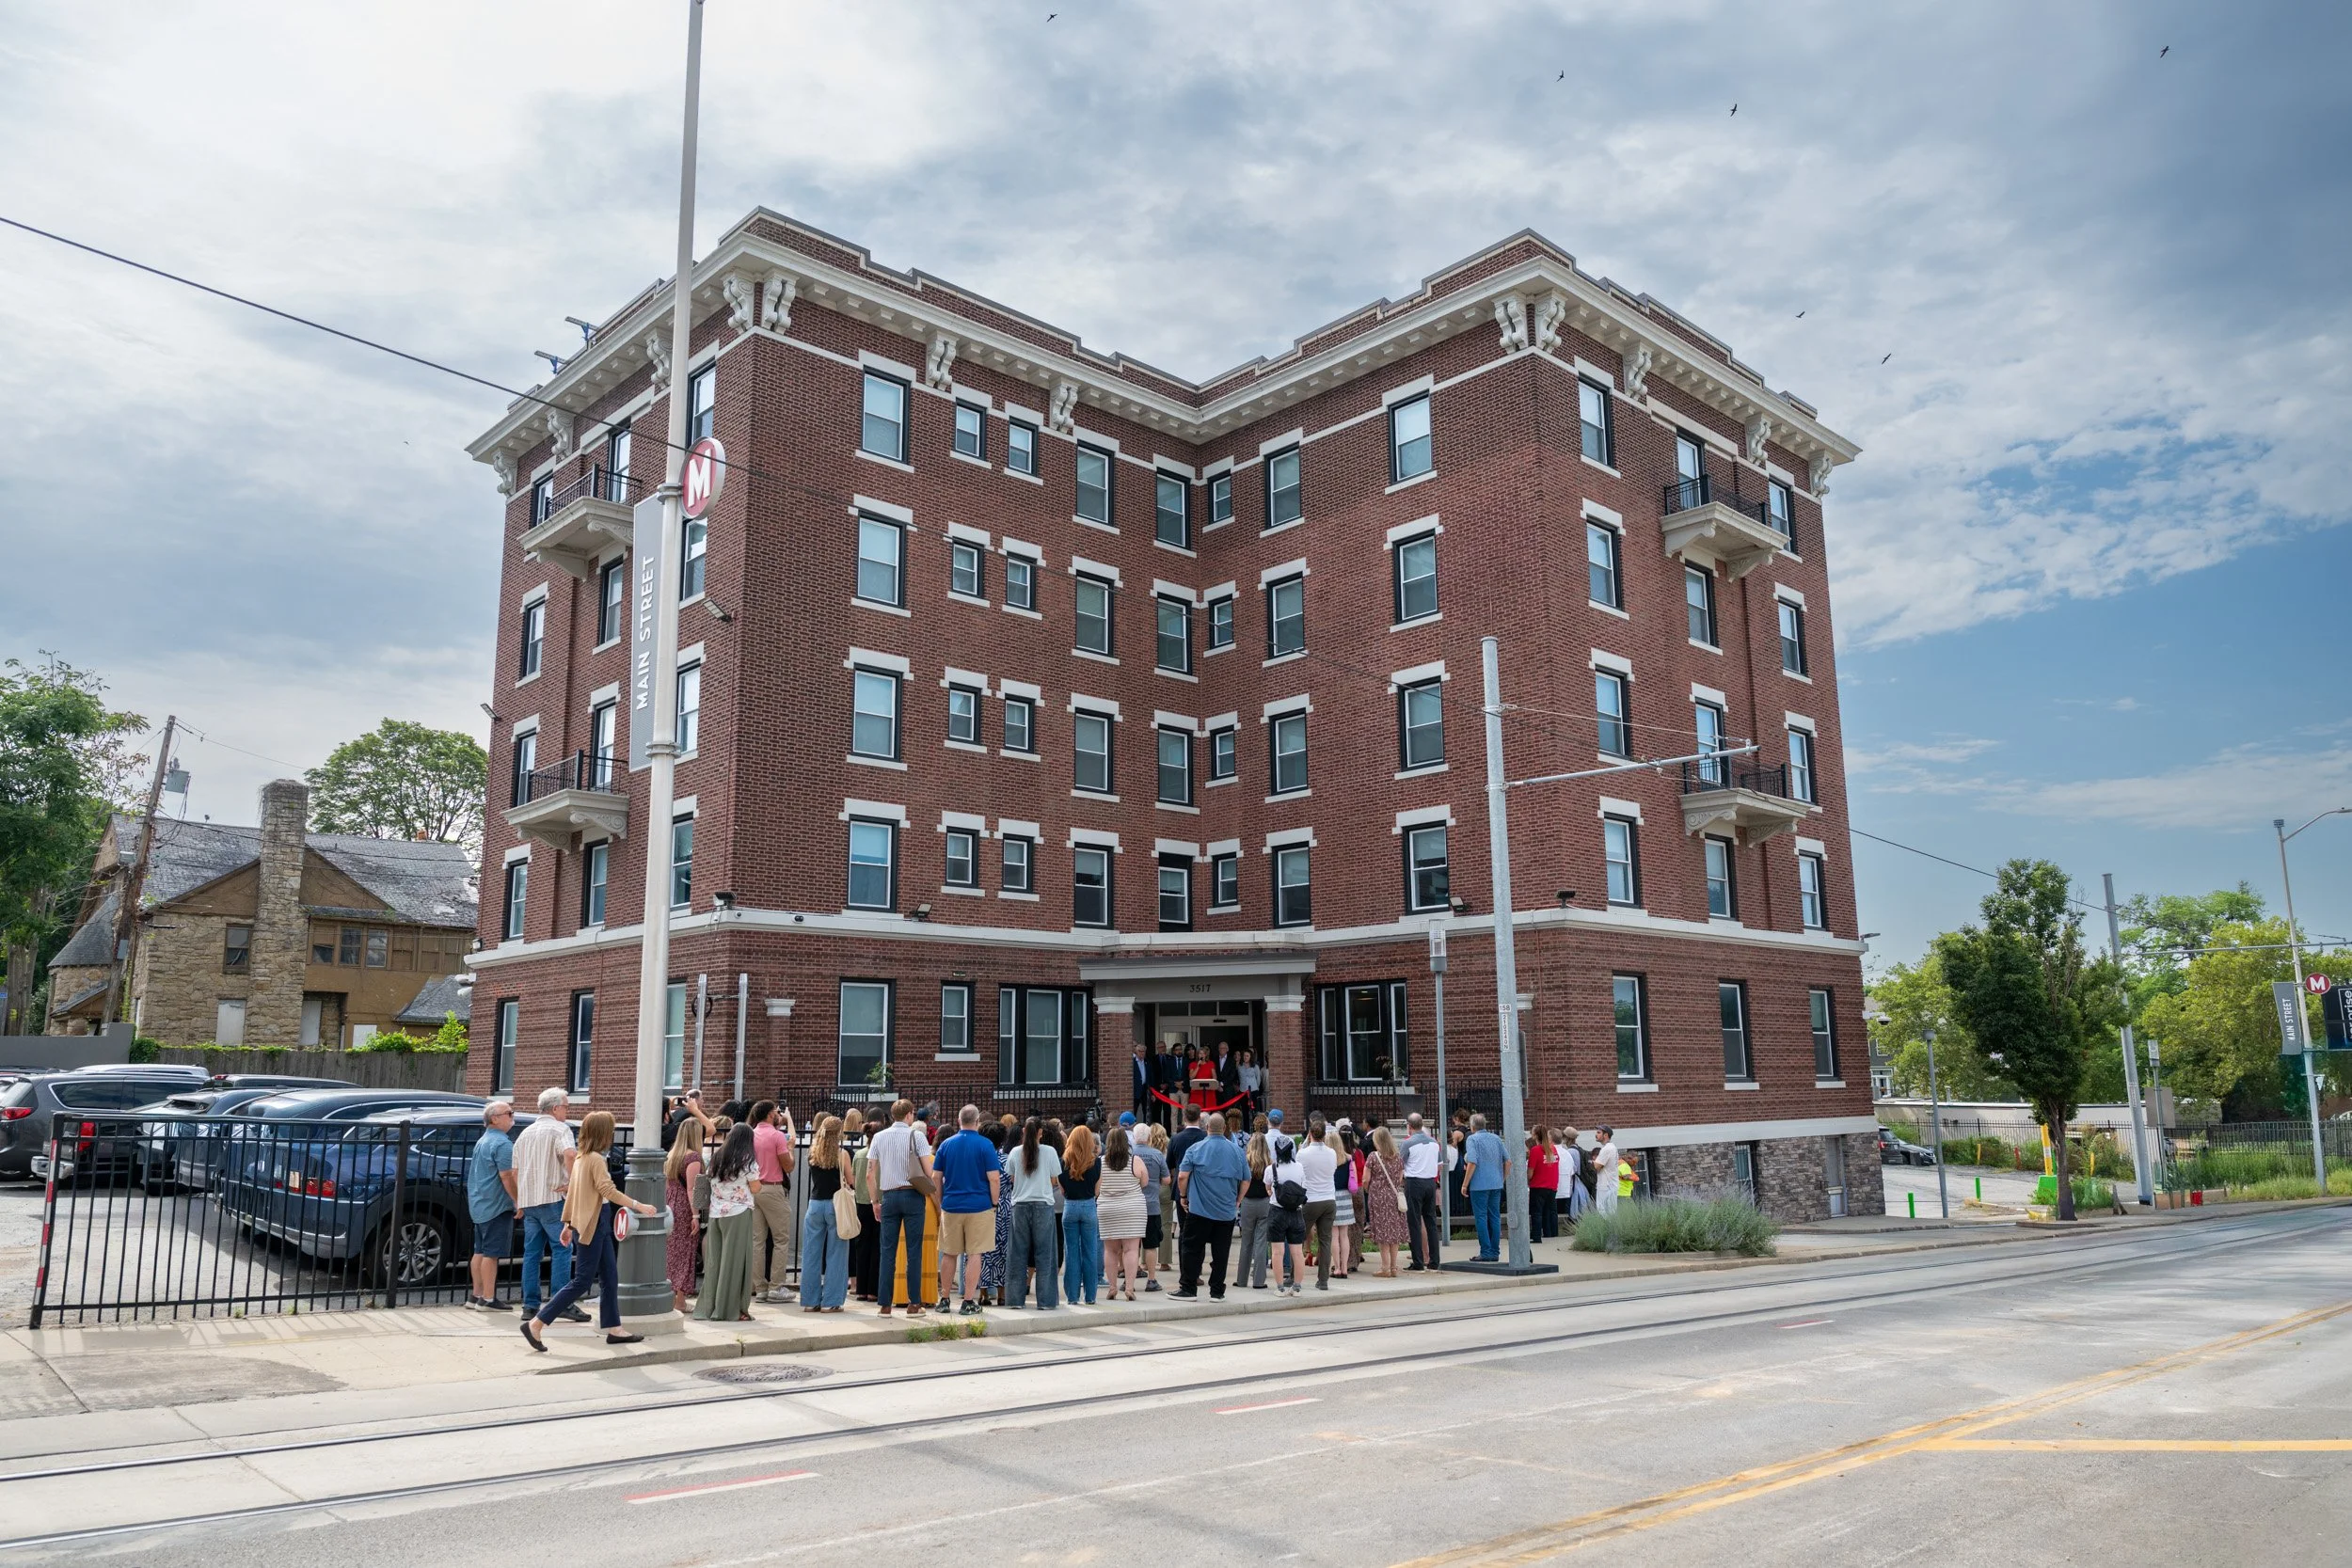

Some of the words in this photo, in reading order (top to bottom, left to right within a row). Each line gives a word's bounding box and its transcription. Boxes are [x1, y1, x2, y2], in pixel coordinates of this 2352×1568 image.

[688, 449, 711, 508] M
[639, 556, 655, 642] STREET
[635, 650, 650, 711] MAIN
[1189, 984, 1211, 993] 3517
[2310, 976, 2326, 991] M
[2282, 998, 2294, 1023] STREET
[617, 1212, 628, 1235] M
